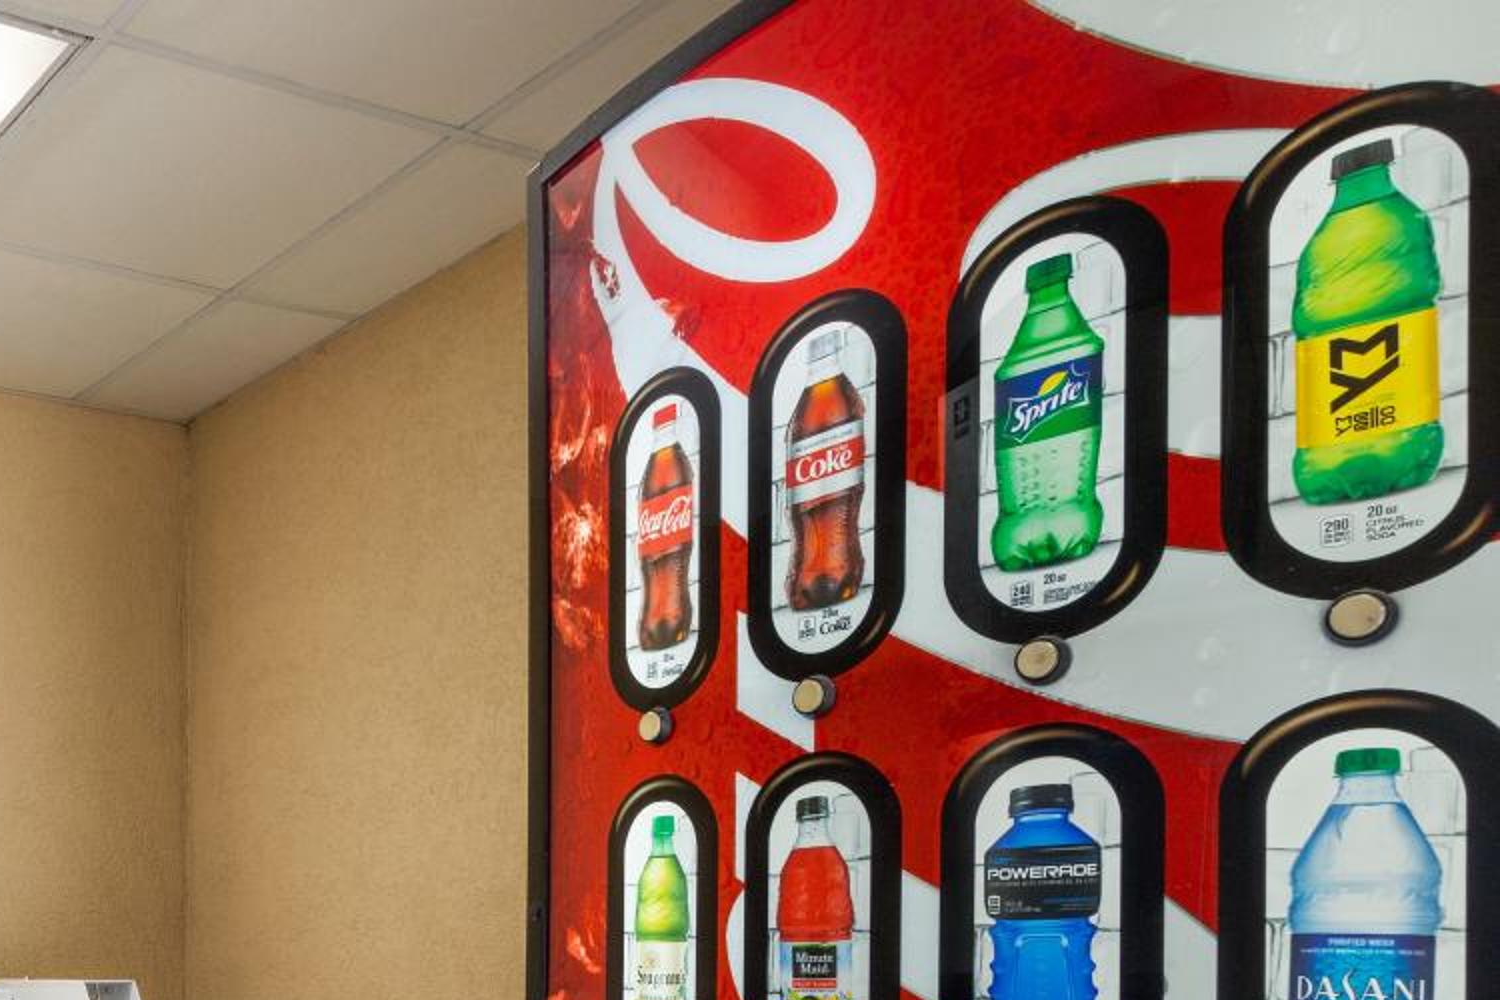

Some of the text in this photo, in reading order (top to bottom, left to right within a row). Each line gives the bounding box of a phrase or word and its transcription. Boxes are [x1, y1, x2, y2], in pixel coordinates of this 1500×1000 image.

[1010, 378, 1082, 433] Sprite
[795, 445, 853, 483] Coke
[1367, 504, 1383, 518] 20
[987, 863, 1100, 881] POWERADE
